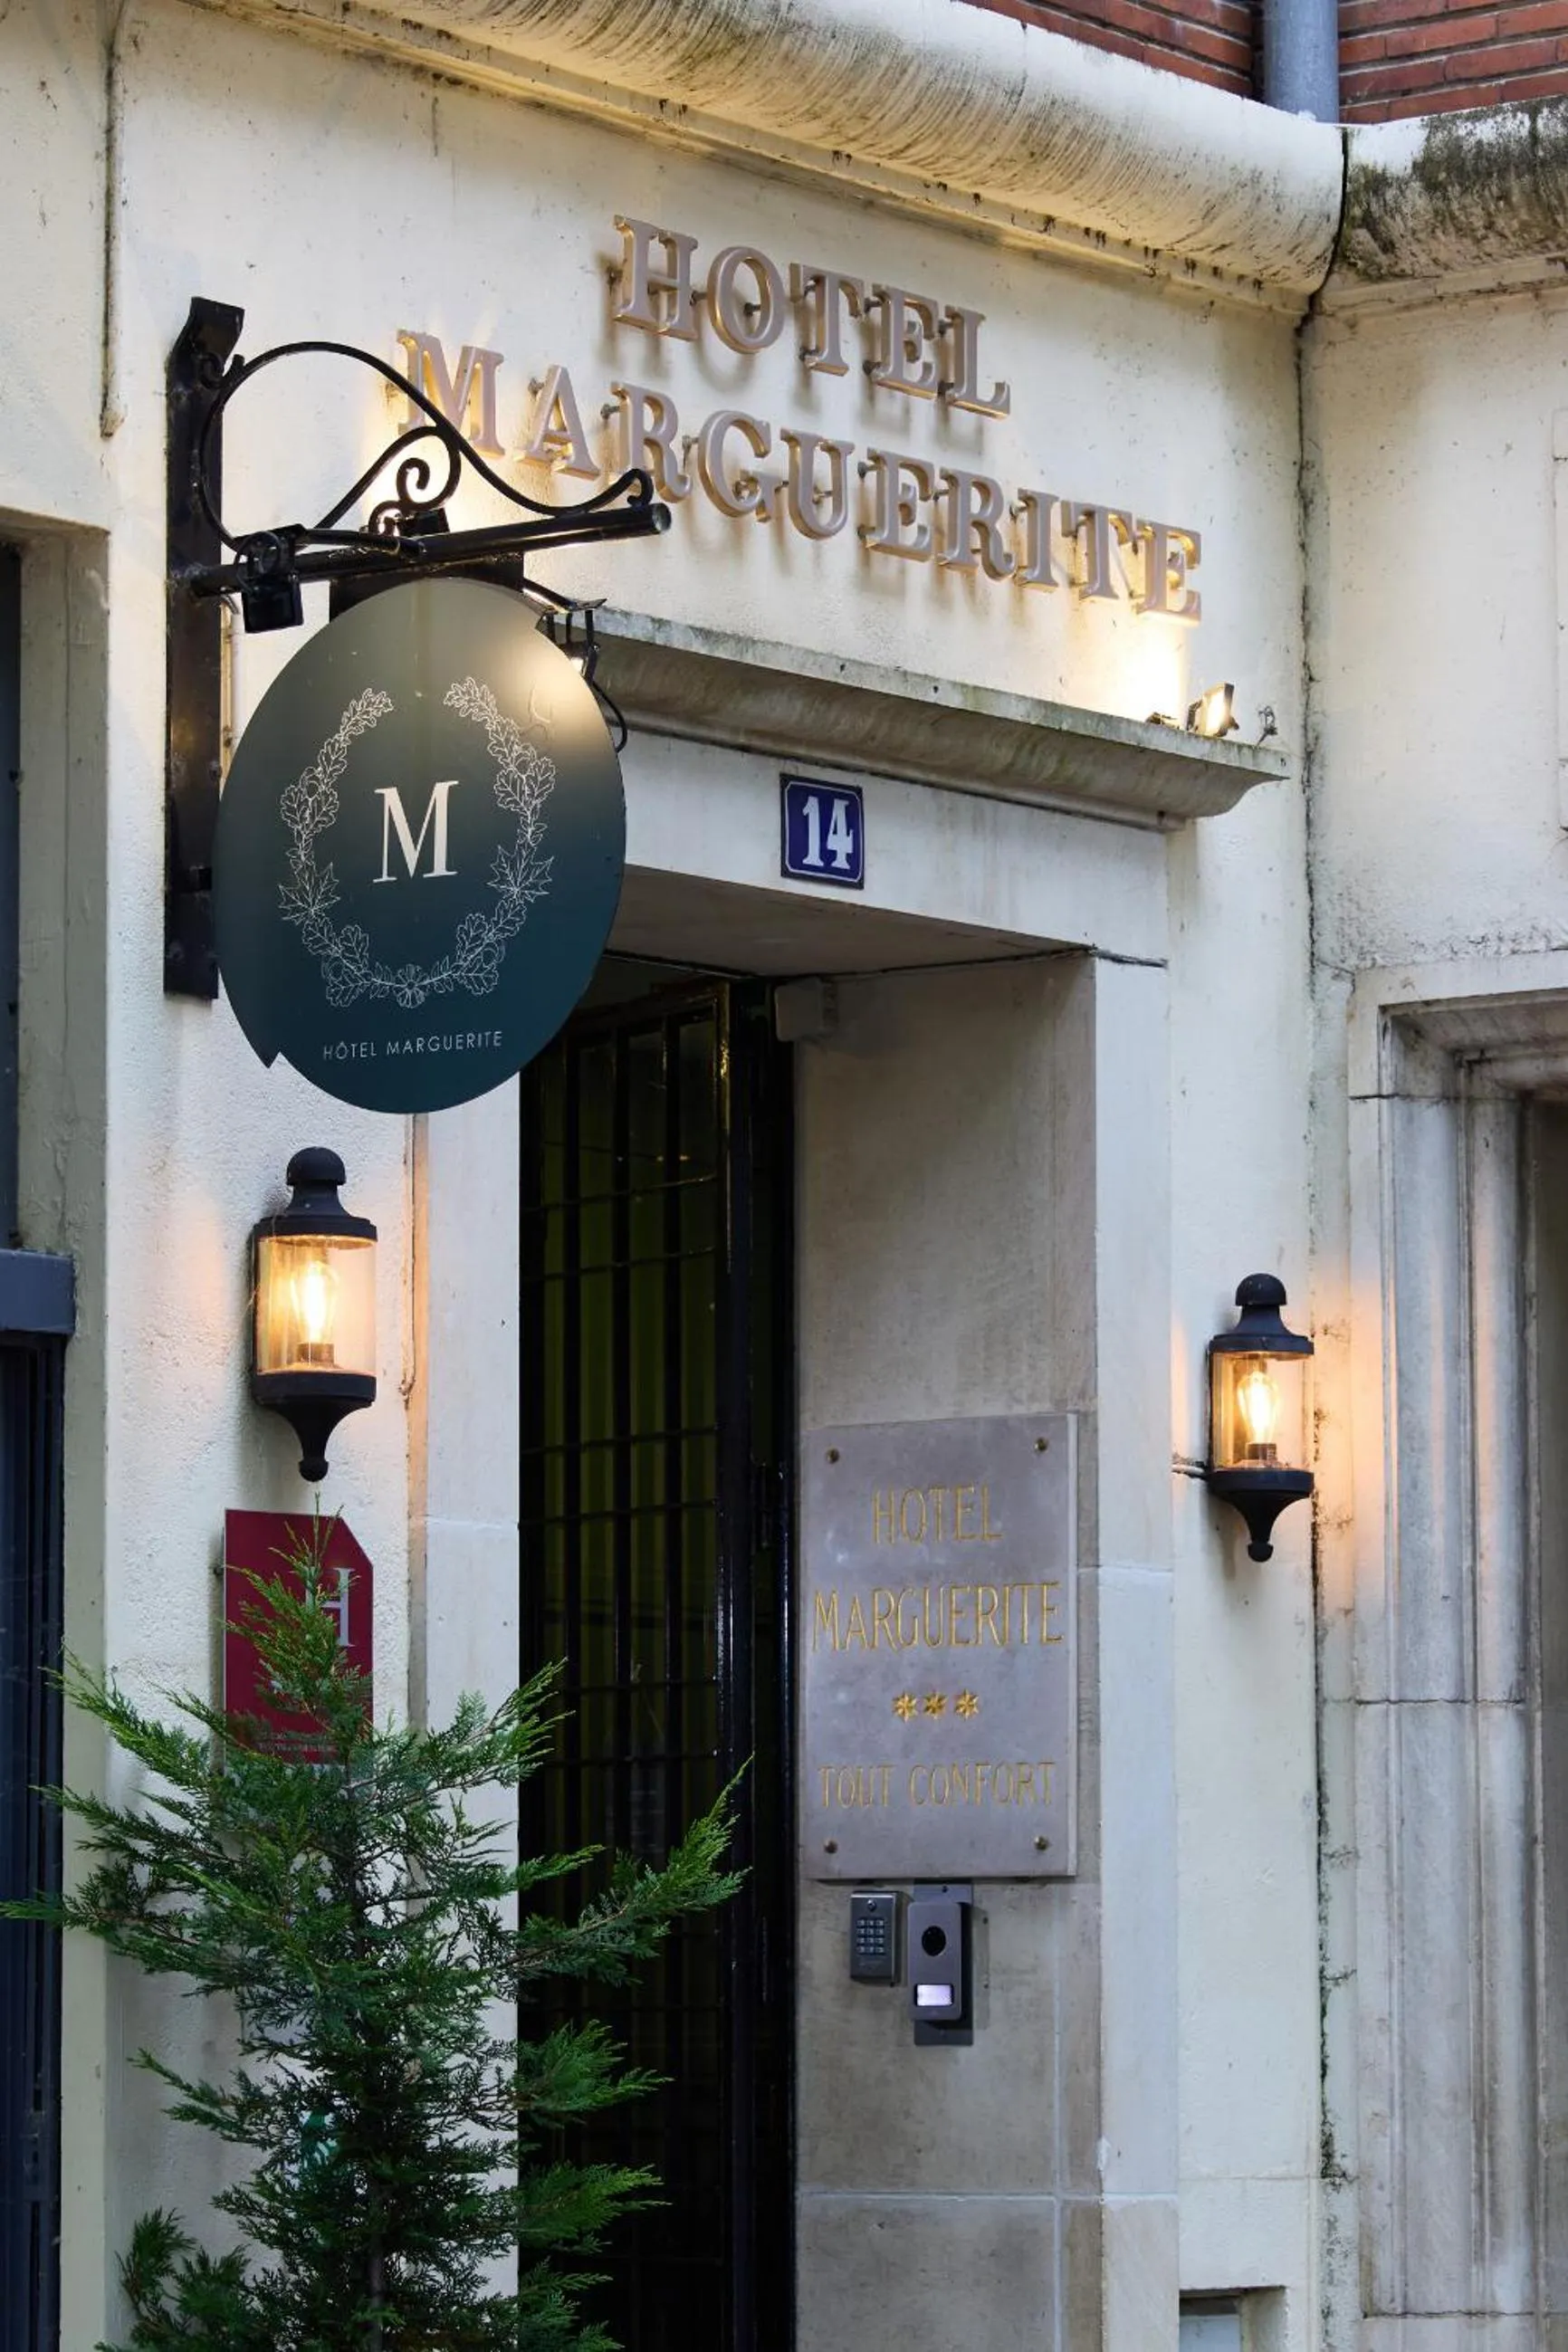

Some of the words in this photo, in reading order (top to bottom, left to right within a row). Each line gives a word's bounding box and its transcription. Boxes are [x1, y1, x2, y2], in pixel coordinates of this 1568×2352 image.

[612, 215, 1010, 419] HOTEL
[397, 329, 1202, 622] MARGUERITE
[373, 779, 459, 884] M
[802, 796, 854, 870] 14
[323, 1041, 378, 1060] HÔTEL
[387, 1030, 502, 1056] MARGUERITE
[871, 1484, 1003, 1544] HOTEL
[813, 1582, 1065, 1651] MARGUERITE
[819, 1764, 893, 1808] TOUT
[910, 1761, 1056, 1805] CONFORT
